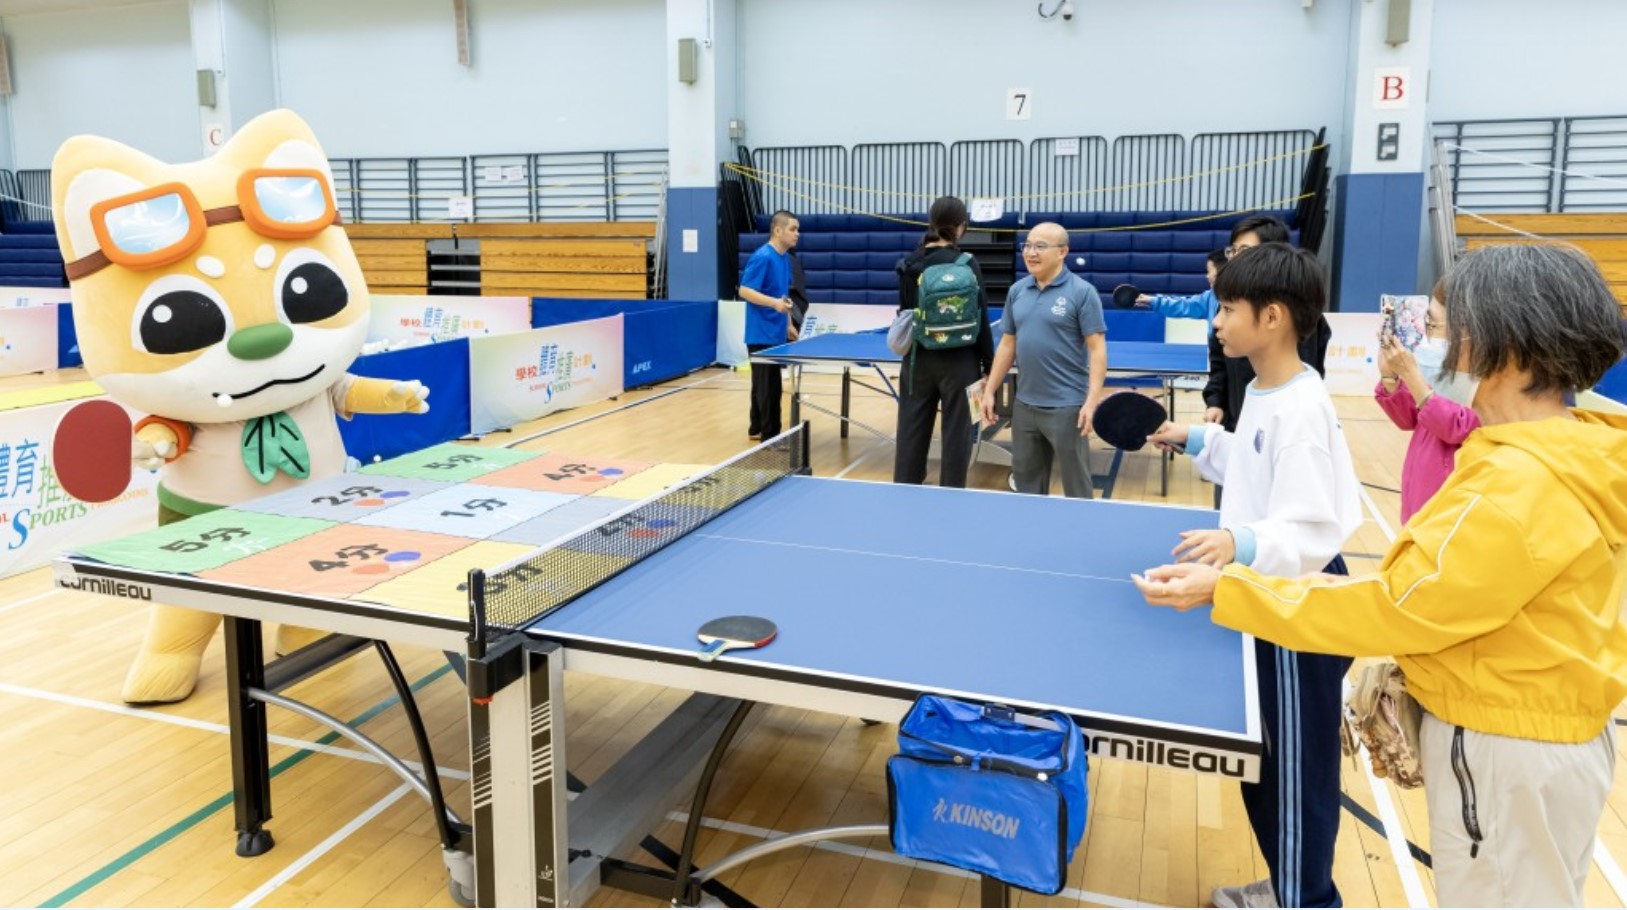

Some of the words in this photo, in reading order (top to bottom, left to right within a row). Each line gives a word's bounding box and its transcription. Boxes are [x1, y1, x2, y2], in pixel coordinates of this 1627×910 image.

[1381, 76, 1404, 100] B
[1014, 93, 1026, 116] 7
[209, 128, 222, 146] C
[632, 361, 653, 374] APEX
[422, 453, 484, 470] 5分
[543, 462, 597, 482] 4分
[311, 485, 383, 507] 2分
[440, 497, 508, 518] 1分
[8, 503, 88, 550] SPORTS
[158, 527, 251, 553] 5分
[308, 543, 389, 573] 4分
[950, 803, 1020, 839] KINSON
